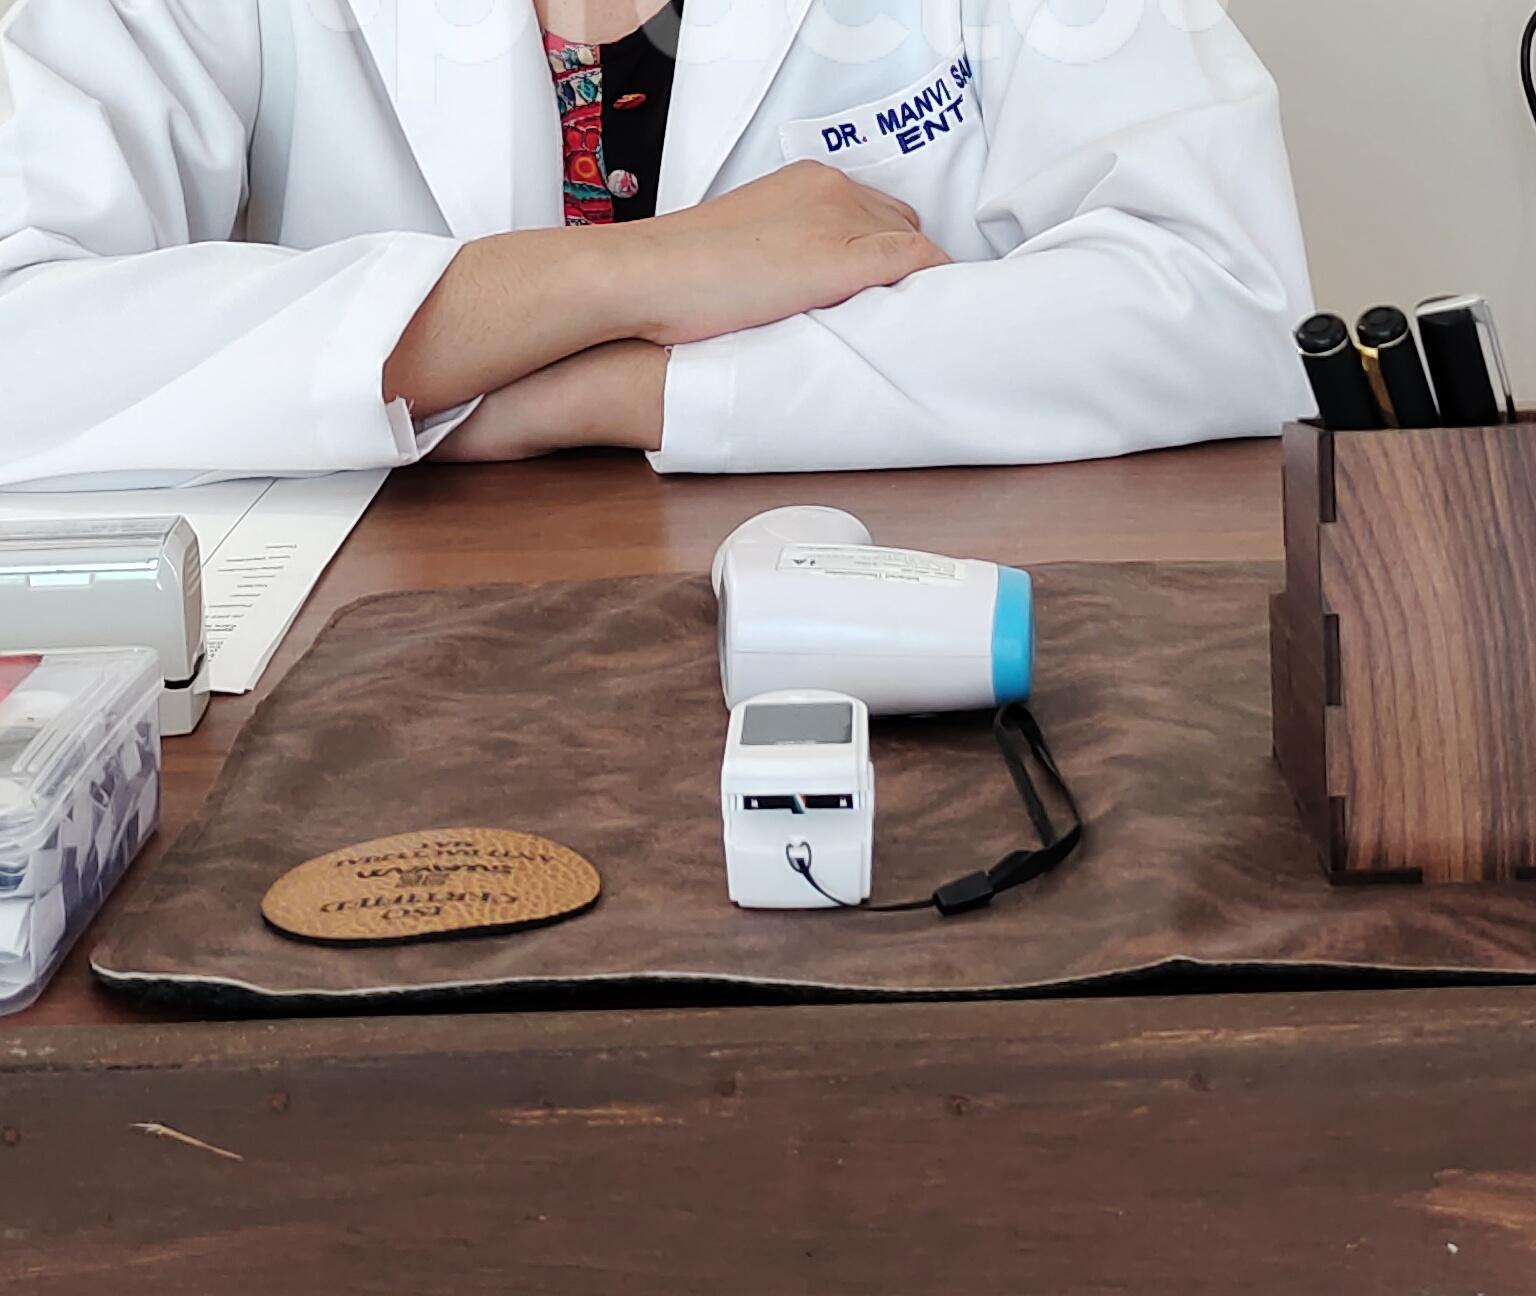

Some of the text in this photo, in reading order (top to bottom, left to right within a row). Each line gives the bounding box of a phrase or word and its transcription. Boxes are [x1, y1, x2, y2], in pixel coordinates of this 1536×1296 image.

[822, 123, 867, 152] DR.
[876, 78, 951, 135] MANVI
[895, 93, 964, 154] ENT
[320, 891, 518, 913] CERTIFIED
